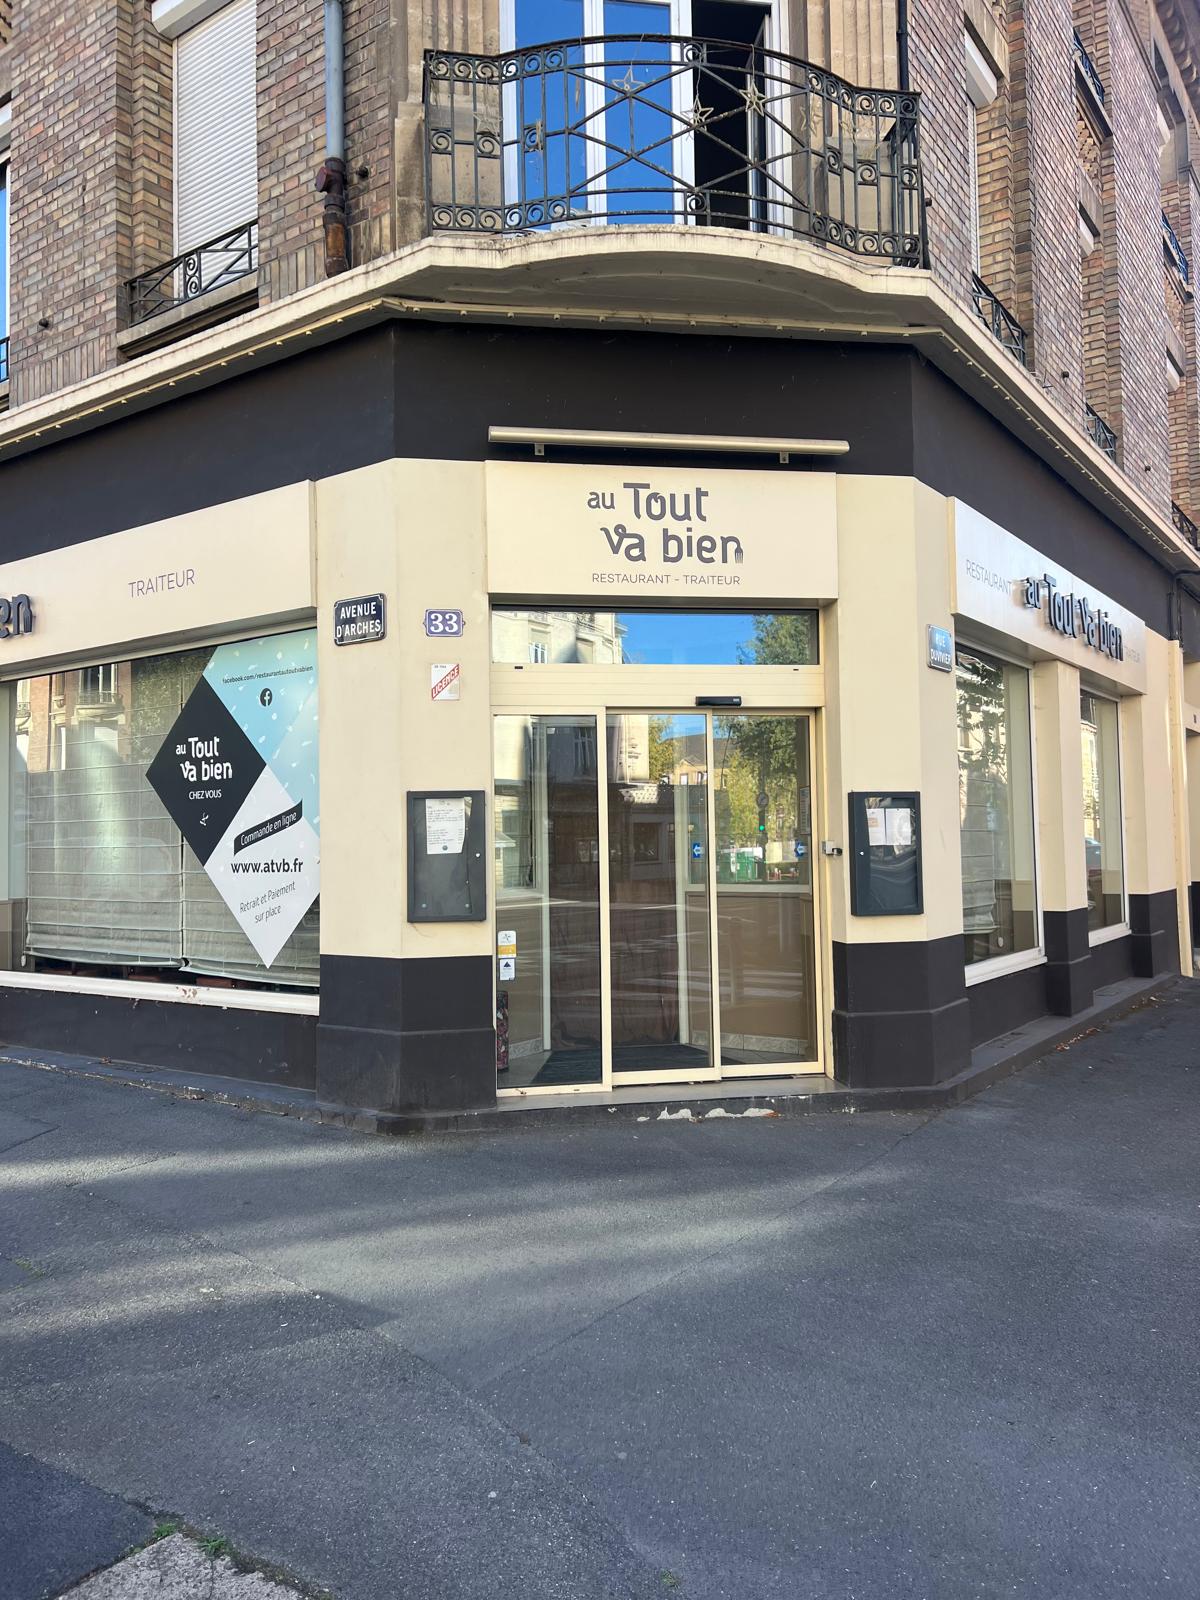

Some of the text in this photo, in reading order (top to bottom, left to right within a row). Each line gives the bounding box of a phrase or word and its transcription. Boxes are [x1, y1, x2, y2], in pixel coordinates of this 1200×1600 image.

[587, 481, 709, 522] au Tout
[661, 527, 744, 565] bien
[127, 568, 195, 599] TRAITEUR
[592, 572, 671, 584] RESTAURANT
[683, 574, 741, 586] TRAITEUR
[966, 559, 1011, 597] RESTAURANT
[340, 601, 377, 620] AVENUE
[1025, 576, 1041, 610] au
[1043, 573, 1077, 639] Tout
[1097, 608, 1124, 662] bien
[336, 619, 382, 638] D'ARCHES
[429, 612, 459, 633] 33
[431, 665, 459, 698] LICENCE
[175, 736, 220, 758] au Tout
[201, 758, 233, 781] bien
[188, 789, 222, 800] CHEZ VOUS
[240, 811, 297, 846] Commande en ligne
[231, 857, 304, 874] www.atvb.fr
[239, 881, 296, 913] Retrait et Paiement
[254, 904, 281, 923] sur place
